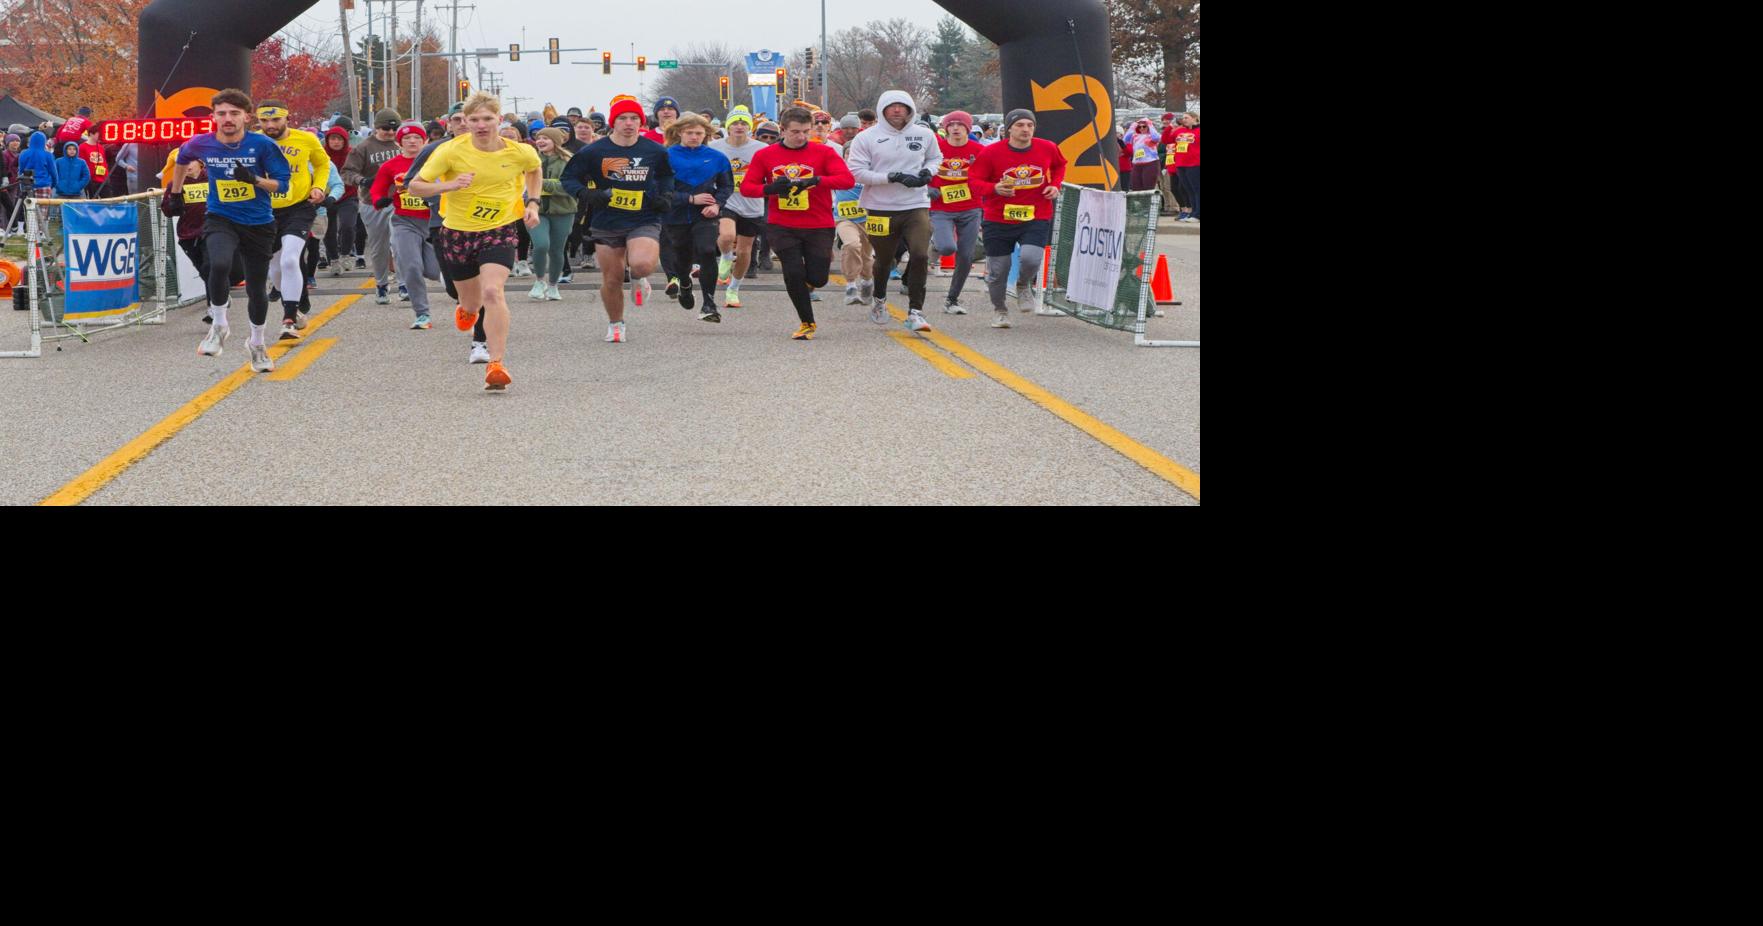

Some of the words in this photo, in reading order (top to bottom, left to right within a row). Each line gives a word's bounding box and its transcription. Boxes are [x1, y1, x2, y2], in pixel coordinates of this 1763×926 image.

[105, 120, 213, 141] 08:00:03
[369, 149, 404, 163] KEYST
[625, 174, 647, 182] RUN
[188, 189, 208, 200] 526
[222, 186, 249, 199] 292
[946, 188, 966, 200] 520
[615, 195, 637, 206] 914
[472, 205, 500, 220] 277
[1008, 209, 1029, 218] 661
